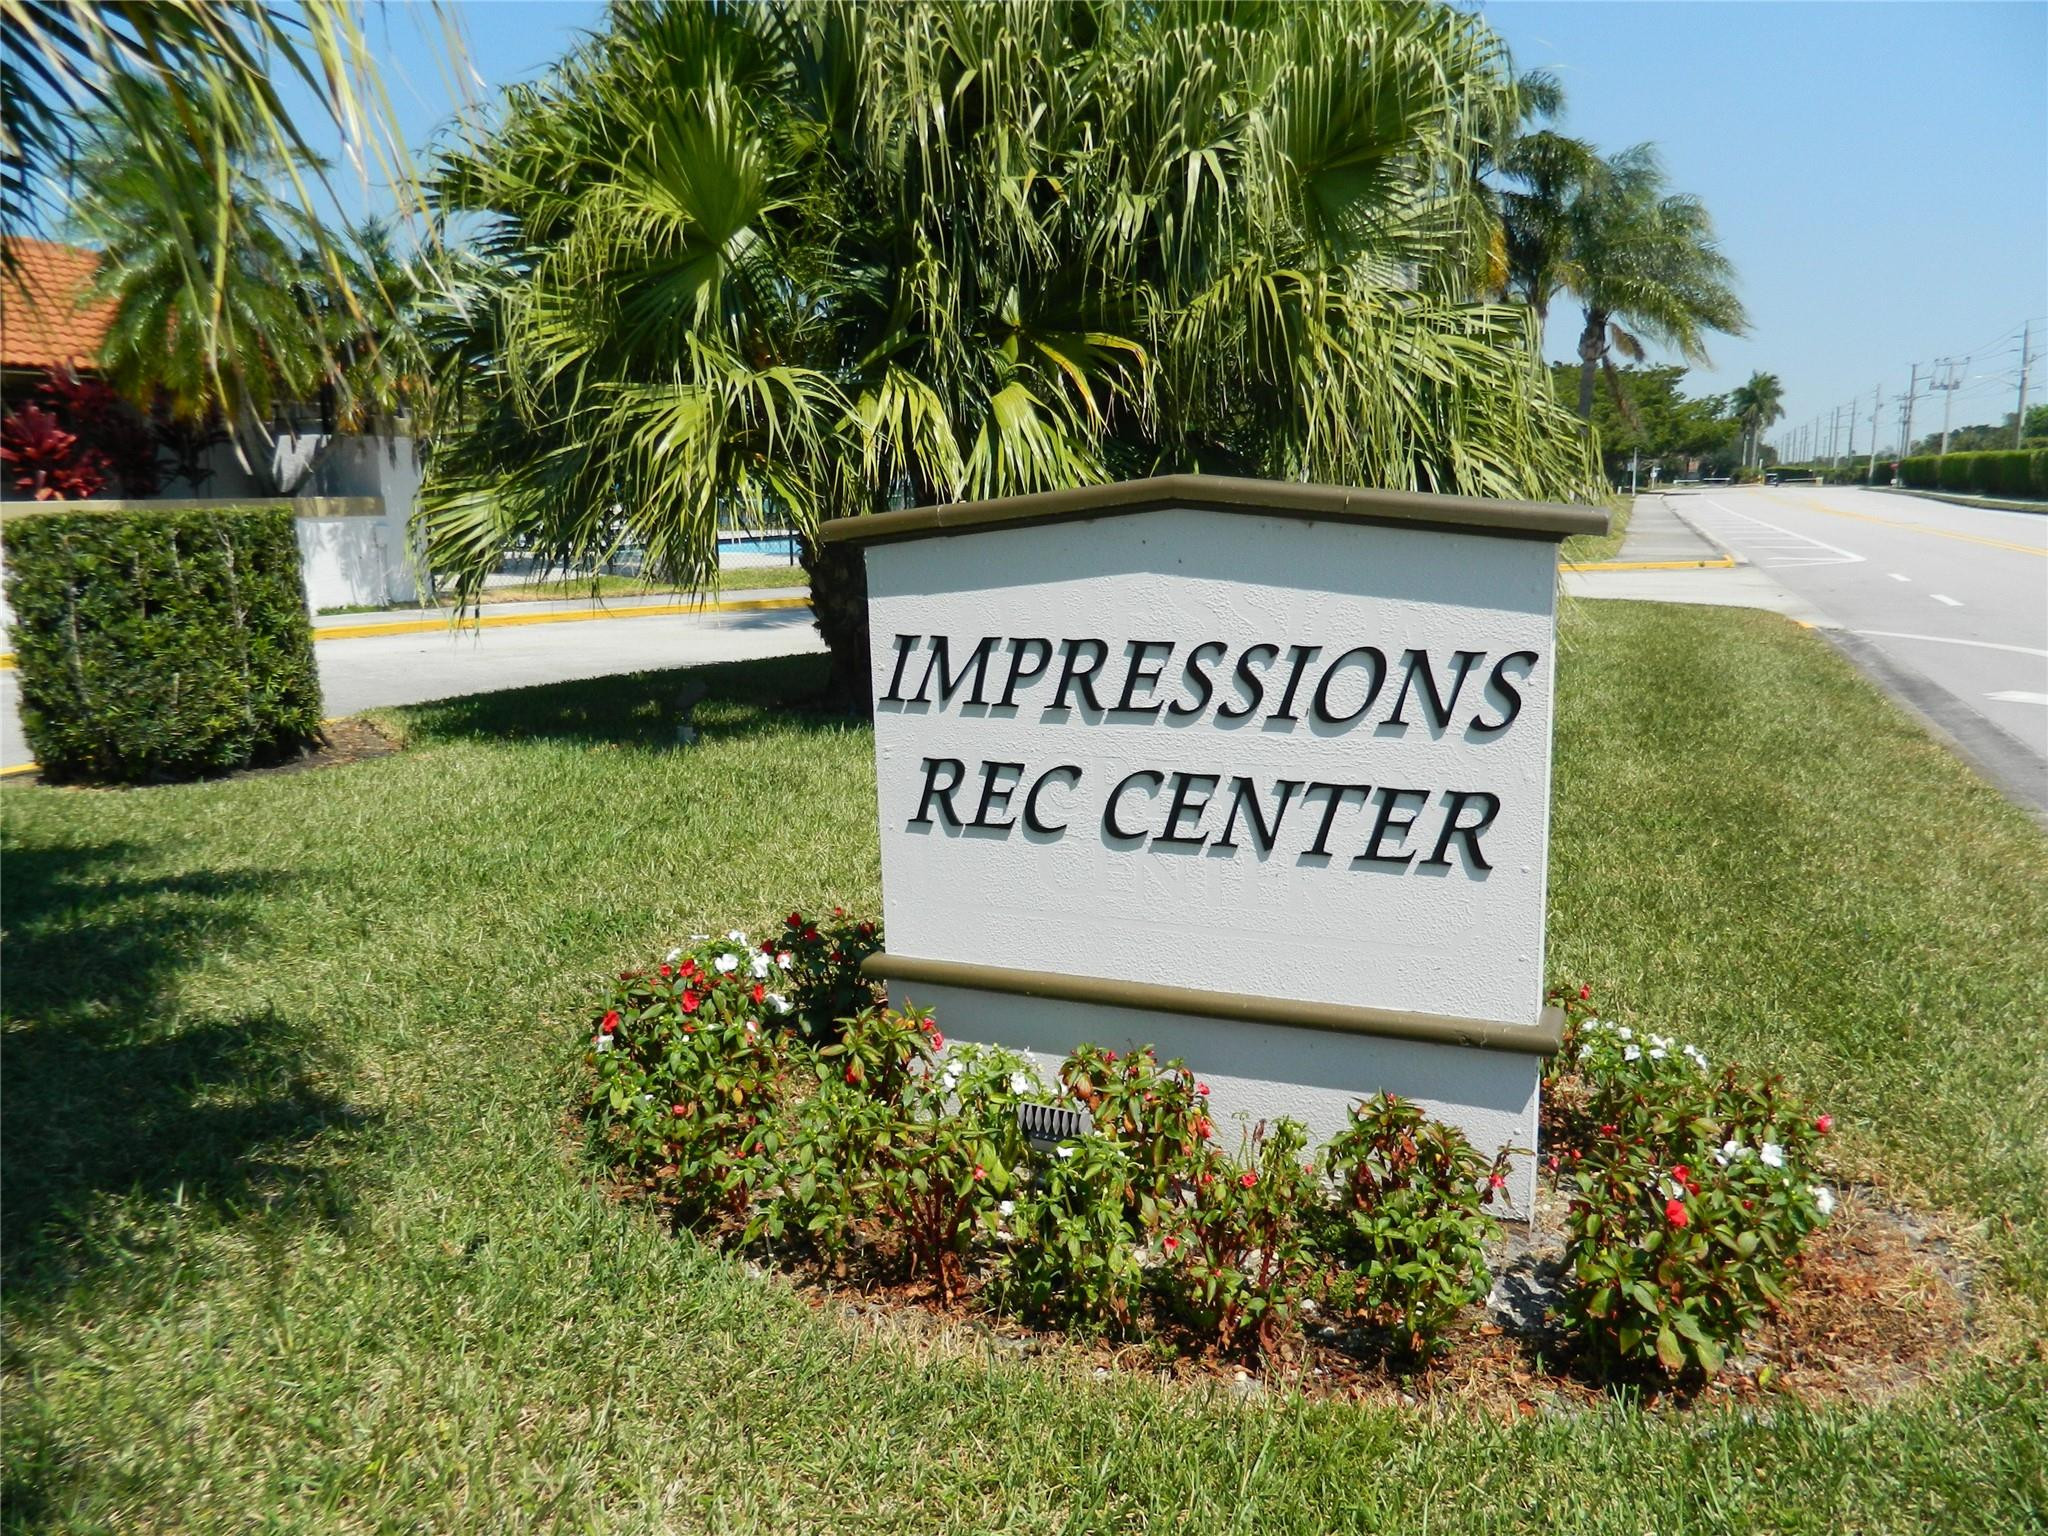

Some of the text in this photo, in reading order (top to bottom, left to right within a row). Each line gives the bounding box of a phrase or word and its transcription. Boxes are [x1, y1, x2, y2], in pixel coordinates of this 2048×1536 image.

[878, 633, 1539, 732] IMPRESSIONS
[907, 757, 1501, 871] REC CENTER
